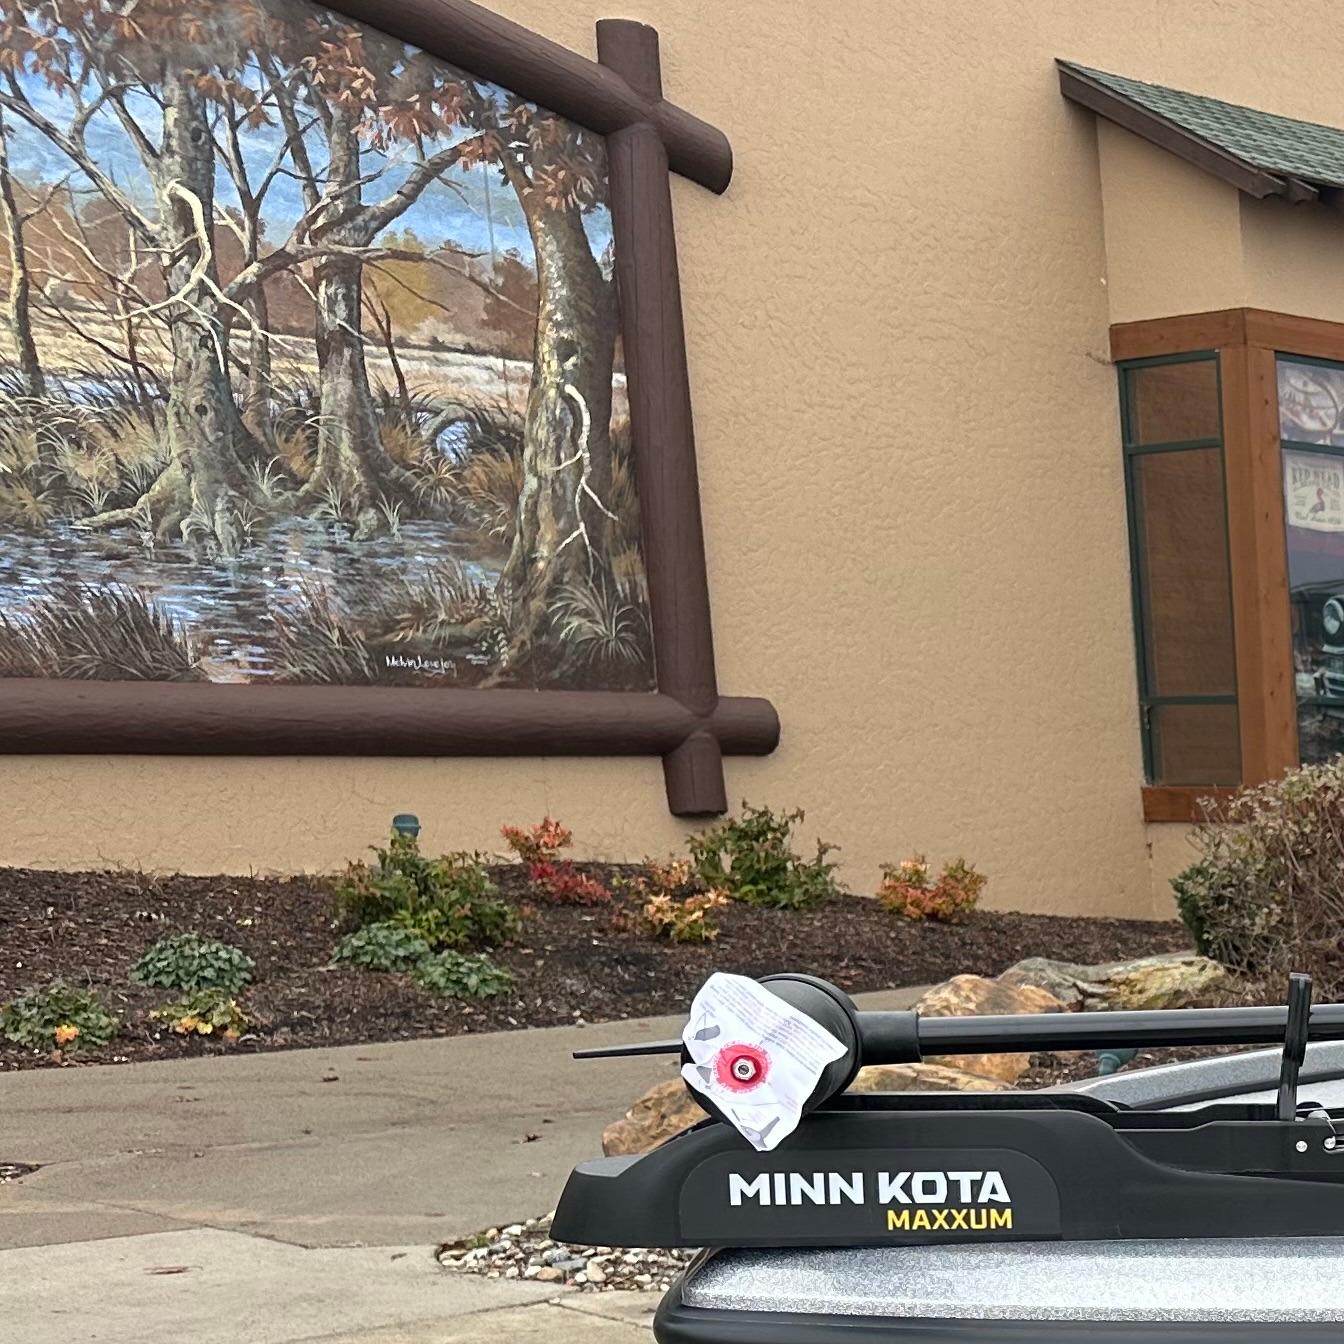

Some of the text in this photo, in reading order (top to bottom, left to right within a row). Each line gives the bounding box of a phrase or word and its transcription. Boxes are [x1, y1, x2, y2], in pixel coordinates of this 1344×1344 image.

[729, 1171, 1011, 1206] MINN KOTA
[887, 1208, 1013, 1230] MAXXUM
